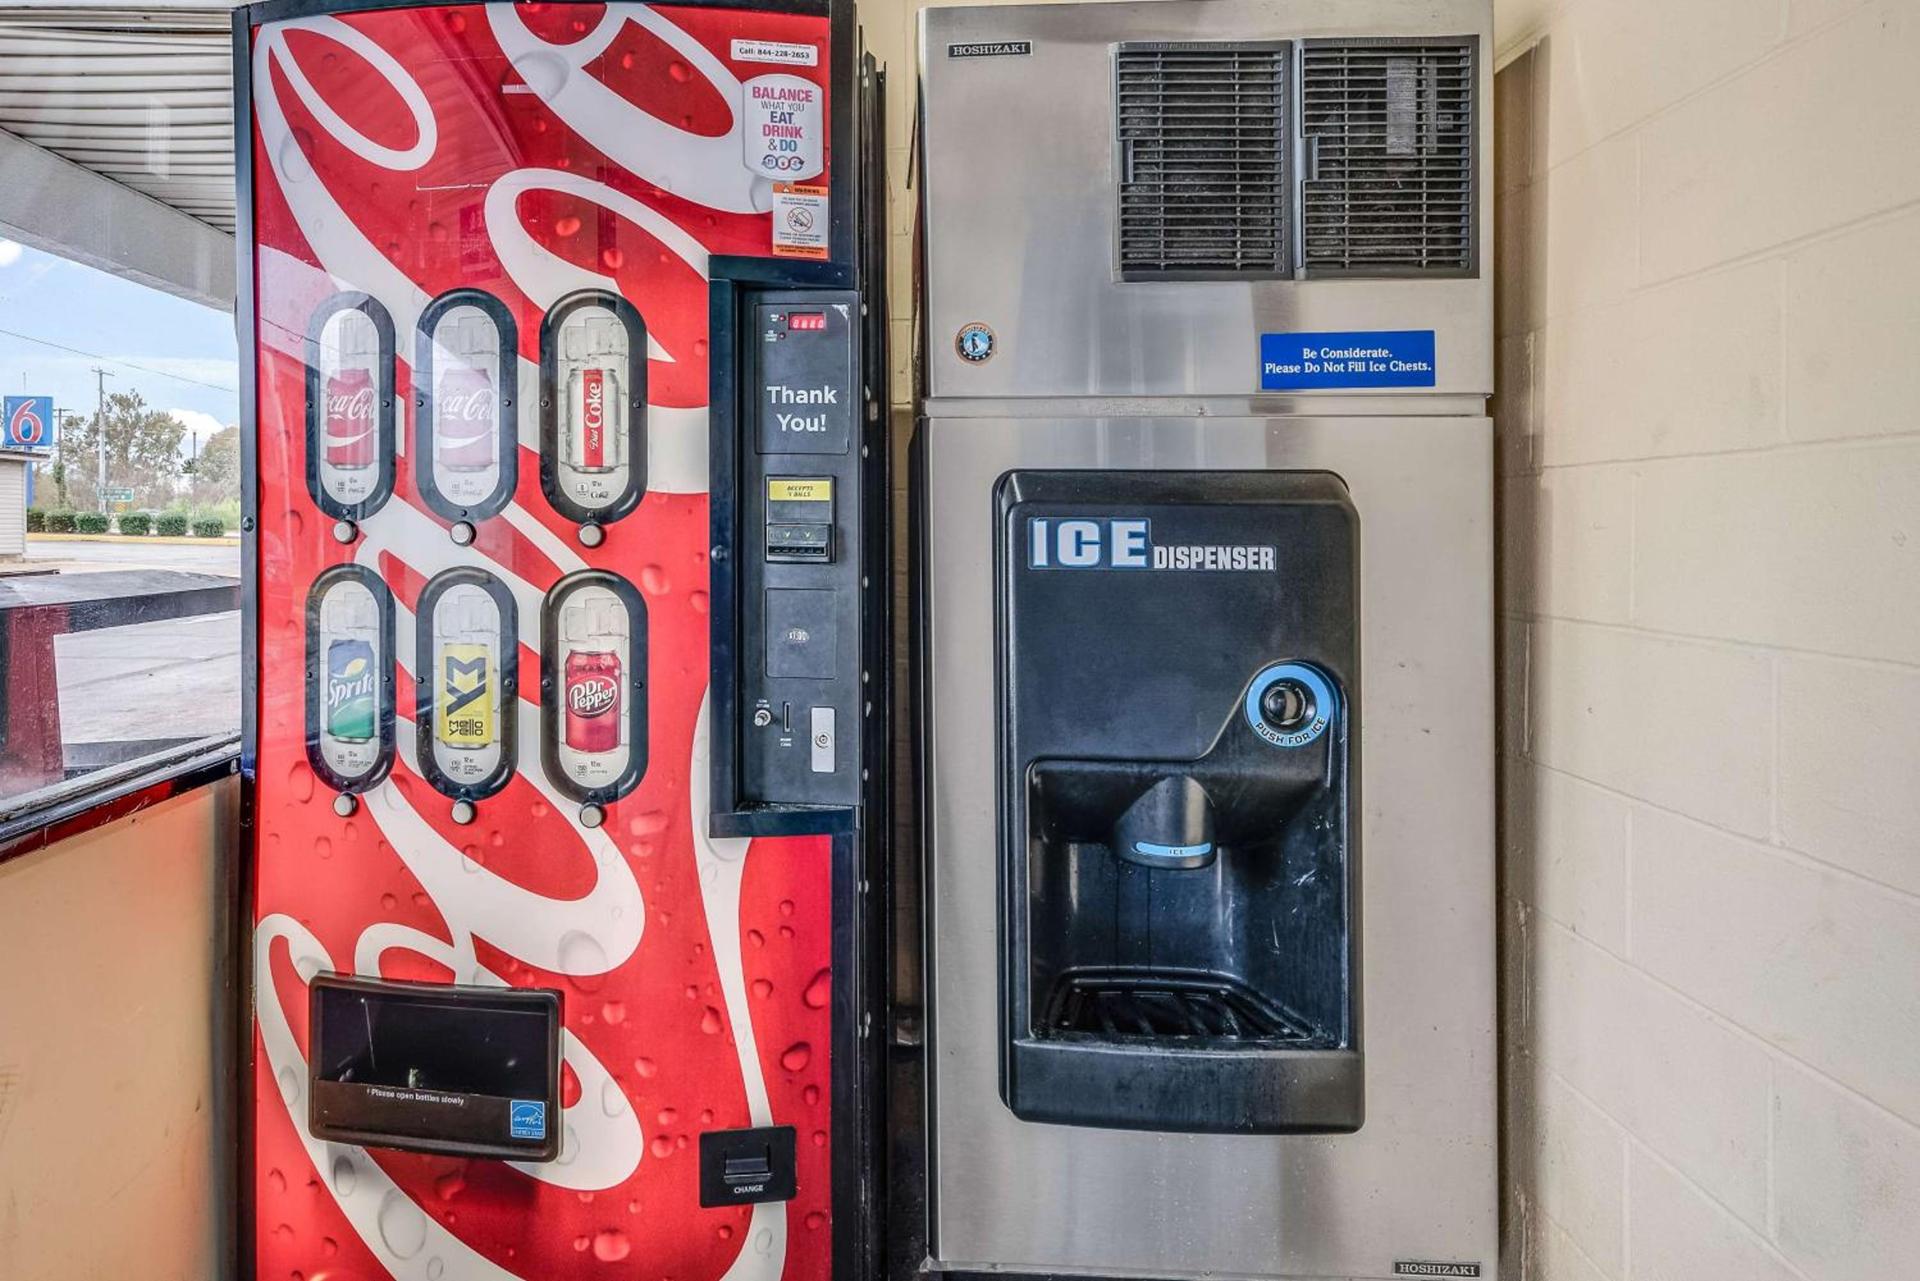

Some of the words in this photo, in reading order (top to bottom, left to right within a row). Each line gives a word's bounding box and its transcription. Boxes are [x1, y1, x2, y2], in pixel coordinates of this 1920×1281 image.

[953, 44, 1025, 55] HOSHIZAKI
[752, 86, 813, 103] BALANCE
[761, 101, 786, 111] WHAT
[787, 102, 805, 112] YOU
[762, 124, 803, 139] DRINK
[768, 138, 778, 151] &
[780, 139, 797, 152] DO
[1303, 348, 1317, 359] Be
[1321, 347, 1393, 359] Considerate.
[1265, 362, 1301, 374] Please
[1304, 362, 1320, 373] Do
[1323, 361, 1344, 373] Not
[1348, 361, 1366, 372] Fill
[1369, 361, 1387, 372] Ice
[1390, 360, 1432, 372] Chests.
[766, 385, 837, 404] Thank
[585, 382, 602, 428] Coke
[10, 399, 43, 443] 6
[776, 414, 826, 432] You!
[1033, 520, 1148, 567] ICE
[1153, 546, 1275, 570] DISPENSER
[328, 672, 374, 708] Sprite
[585, 680, 604, 696] Dr
[571, 684, 615, 711] Pepper
[1255, 722, 1284, 744] PUSH
[1288, 732, 1311, 744] FOR
[1311, 717, 1326, 734] ICE
[371, 1088, 395, 1098] Please
[396, 1092, 414, 1101] open
[415, 1093, 440, 1103] bottles
[441, 1096, 464, 1106] slowly
[1400, 1264, 1475, 1275] HOSHIZAKI
